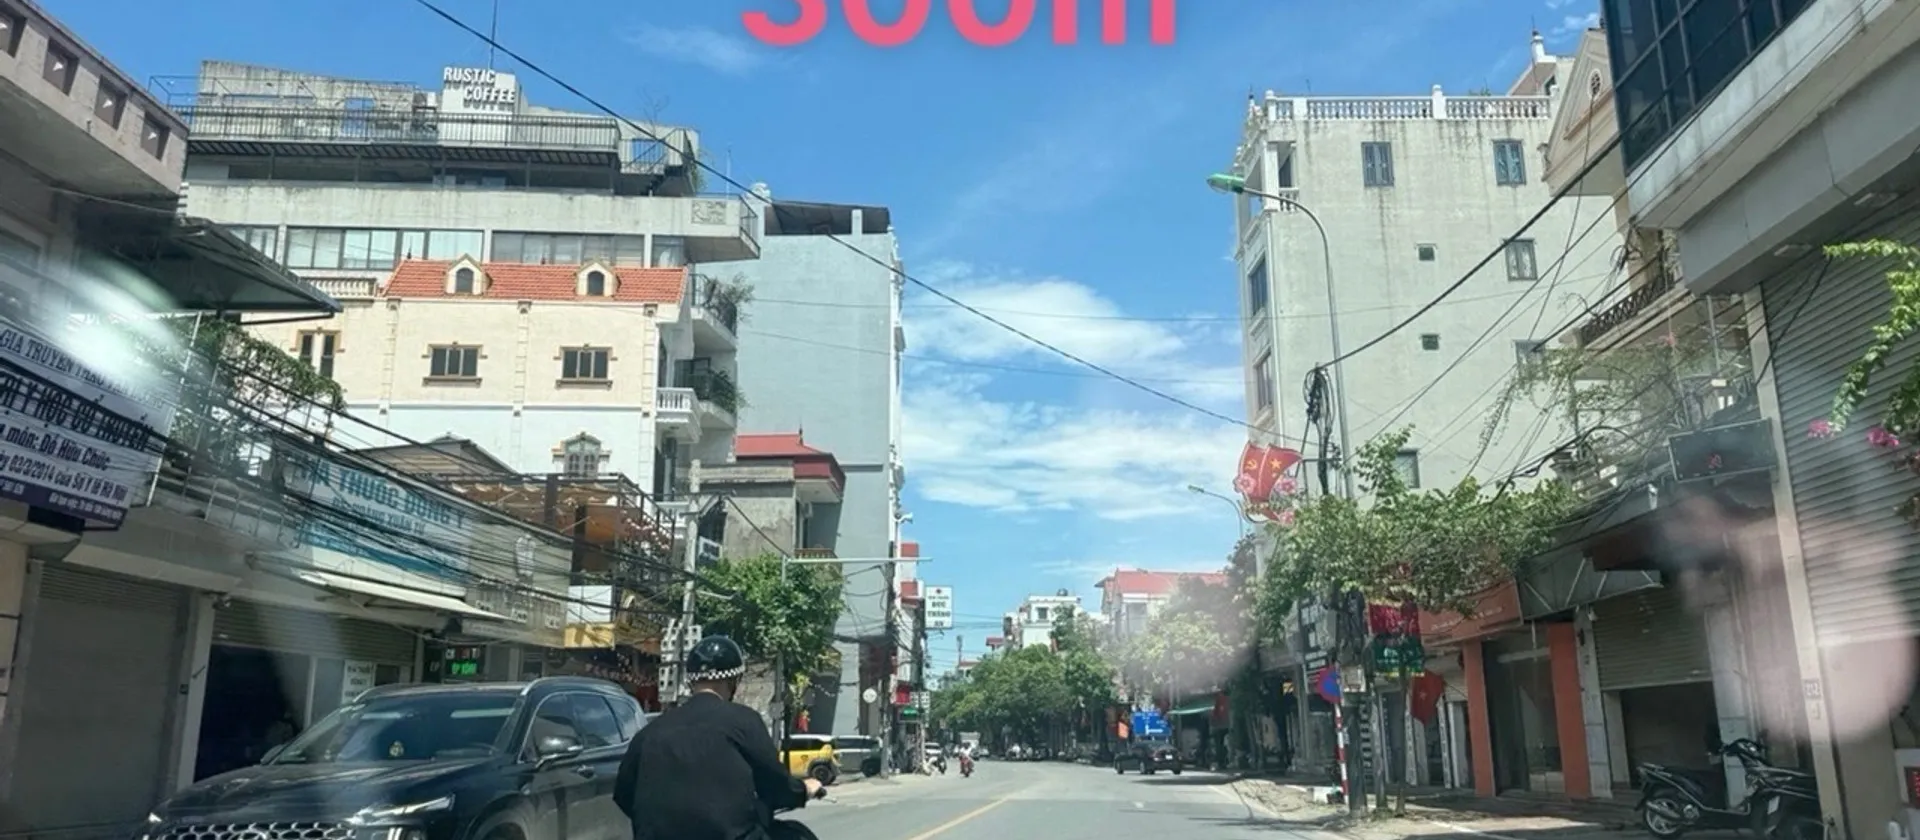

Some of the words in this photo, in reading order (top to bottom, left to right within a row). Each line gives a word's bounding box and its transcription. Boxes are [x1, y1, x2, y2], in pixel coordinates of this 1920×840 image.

[443, 66, 496, 84] RUSTIC
[464, 86, 516, 104] COFFEE
[0, 329, 24, 354] GIA
[36, 383, 70, 427] HỌC
[339, 467, 400, 510] THUỐC
